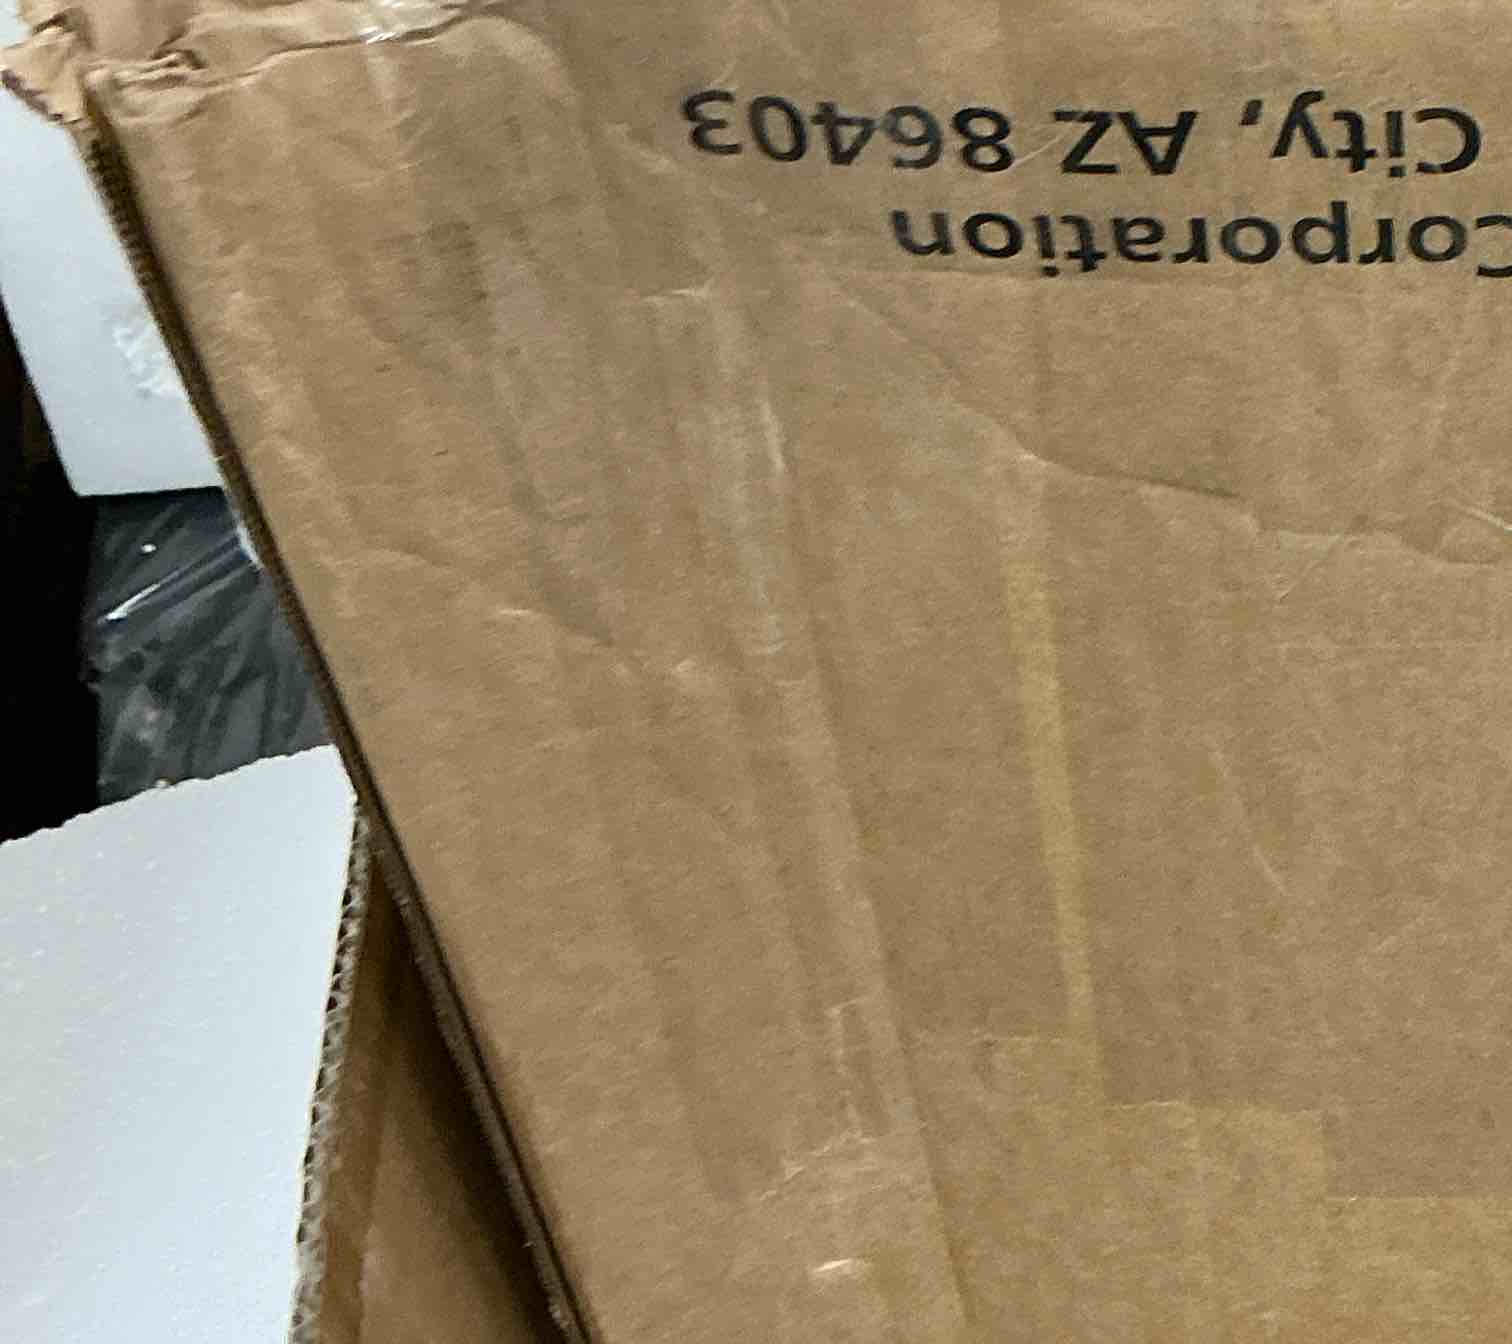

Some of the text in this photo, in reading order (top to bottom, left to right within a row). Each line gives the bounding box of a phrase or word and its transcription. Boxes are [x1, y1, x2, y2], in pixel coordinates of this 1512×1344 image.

[681, 87, 1015, 174] 86403
[1050, 106, 1199, 177] AZ
[1239, 90, 1483, 179] City,
